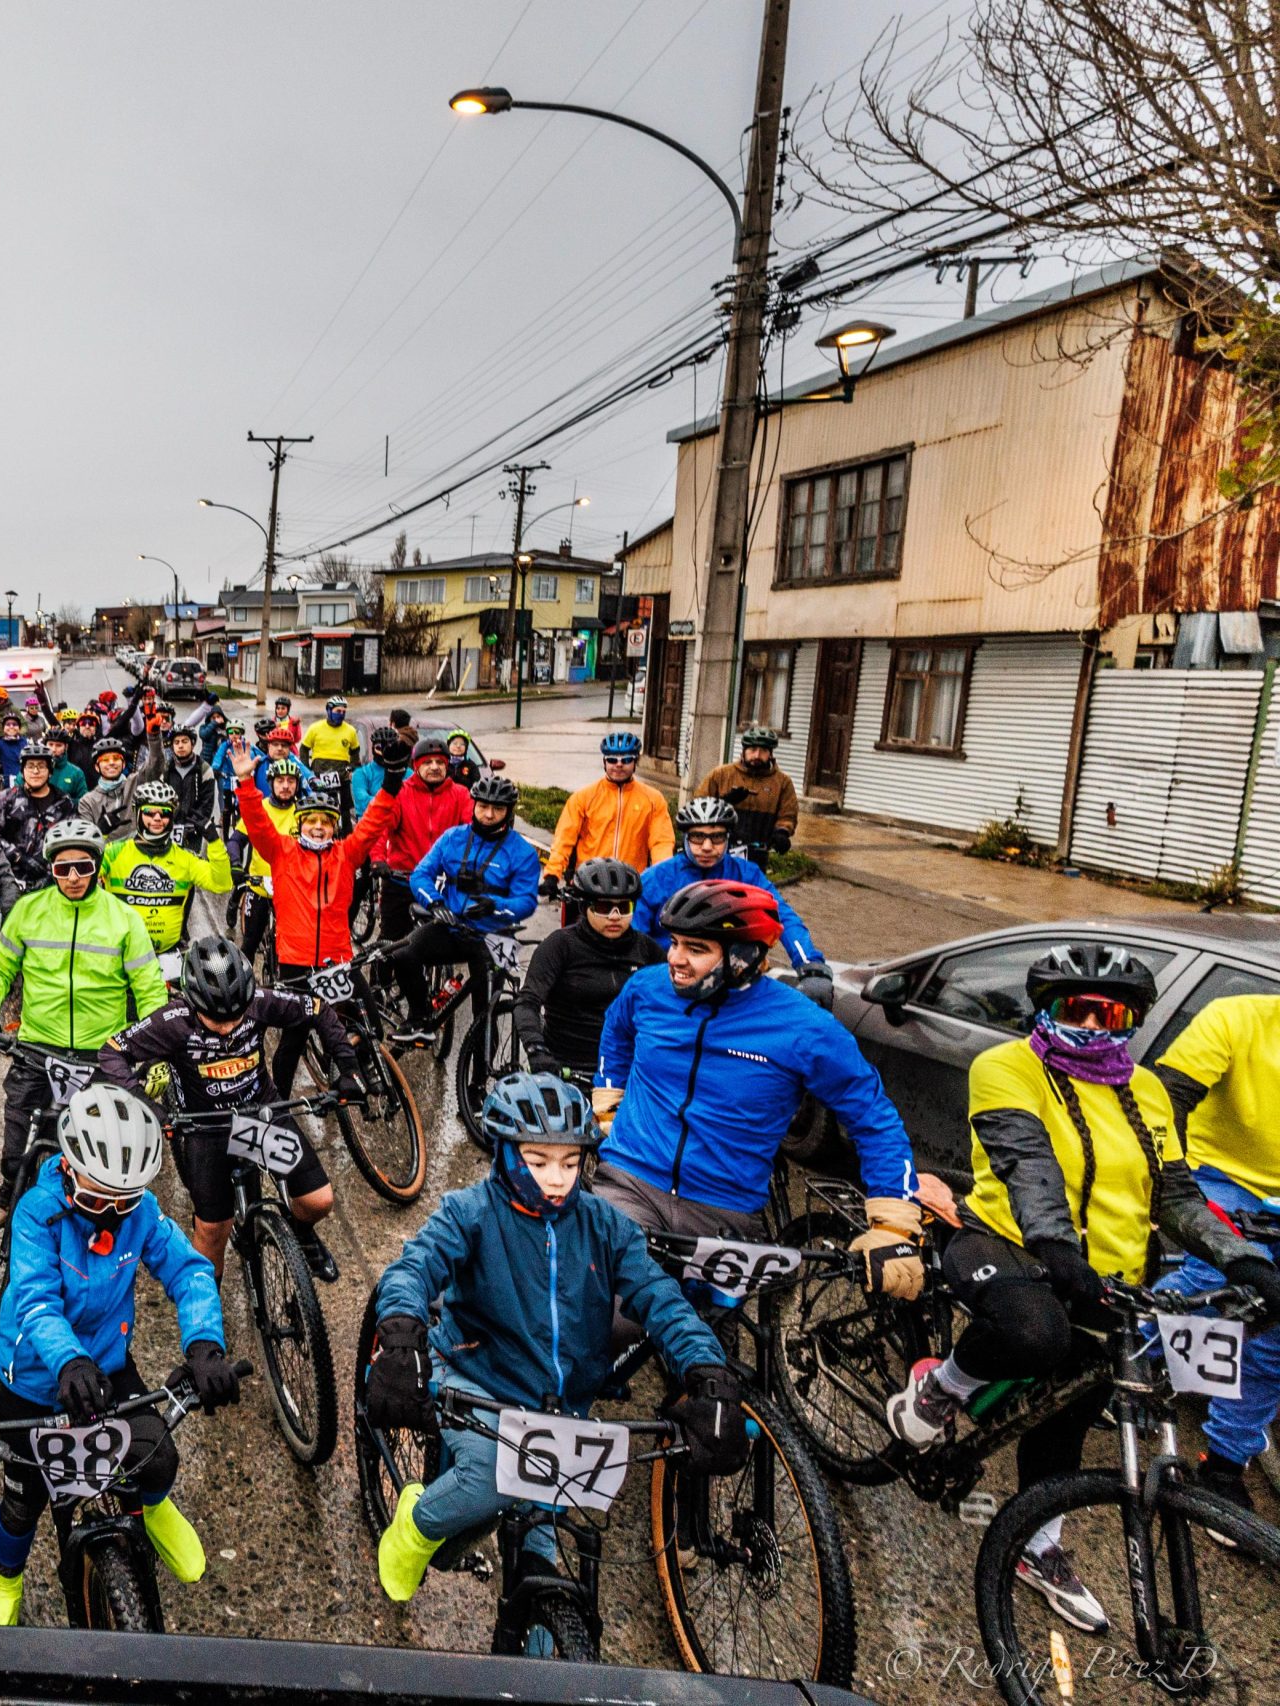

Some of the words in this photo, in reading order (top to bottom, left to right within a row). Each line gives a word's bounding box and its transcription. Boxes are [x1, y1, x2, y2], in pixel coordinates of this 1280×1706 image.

[135, 896, 172, 906] GIANT
[317, 969, 354, 999] 89
[206, 1057, 256, 1078] PIRELLI
[231, 1125, 300, 1166] 43
[701, 1248, 791, 1292] 66
[36, 1425, 123, 1491] 88
[517, 1428, 615, 1494] 67
